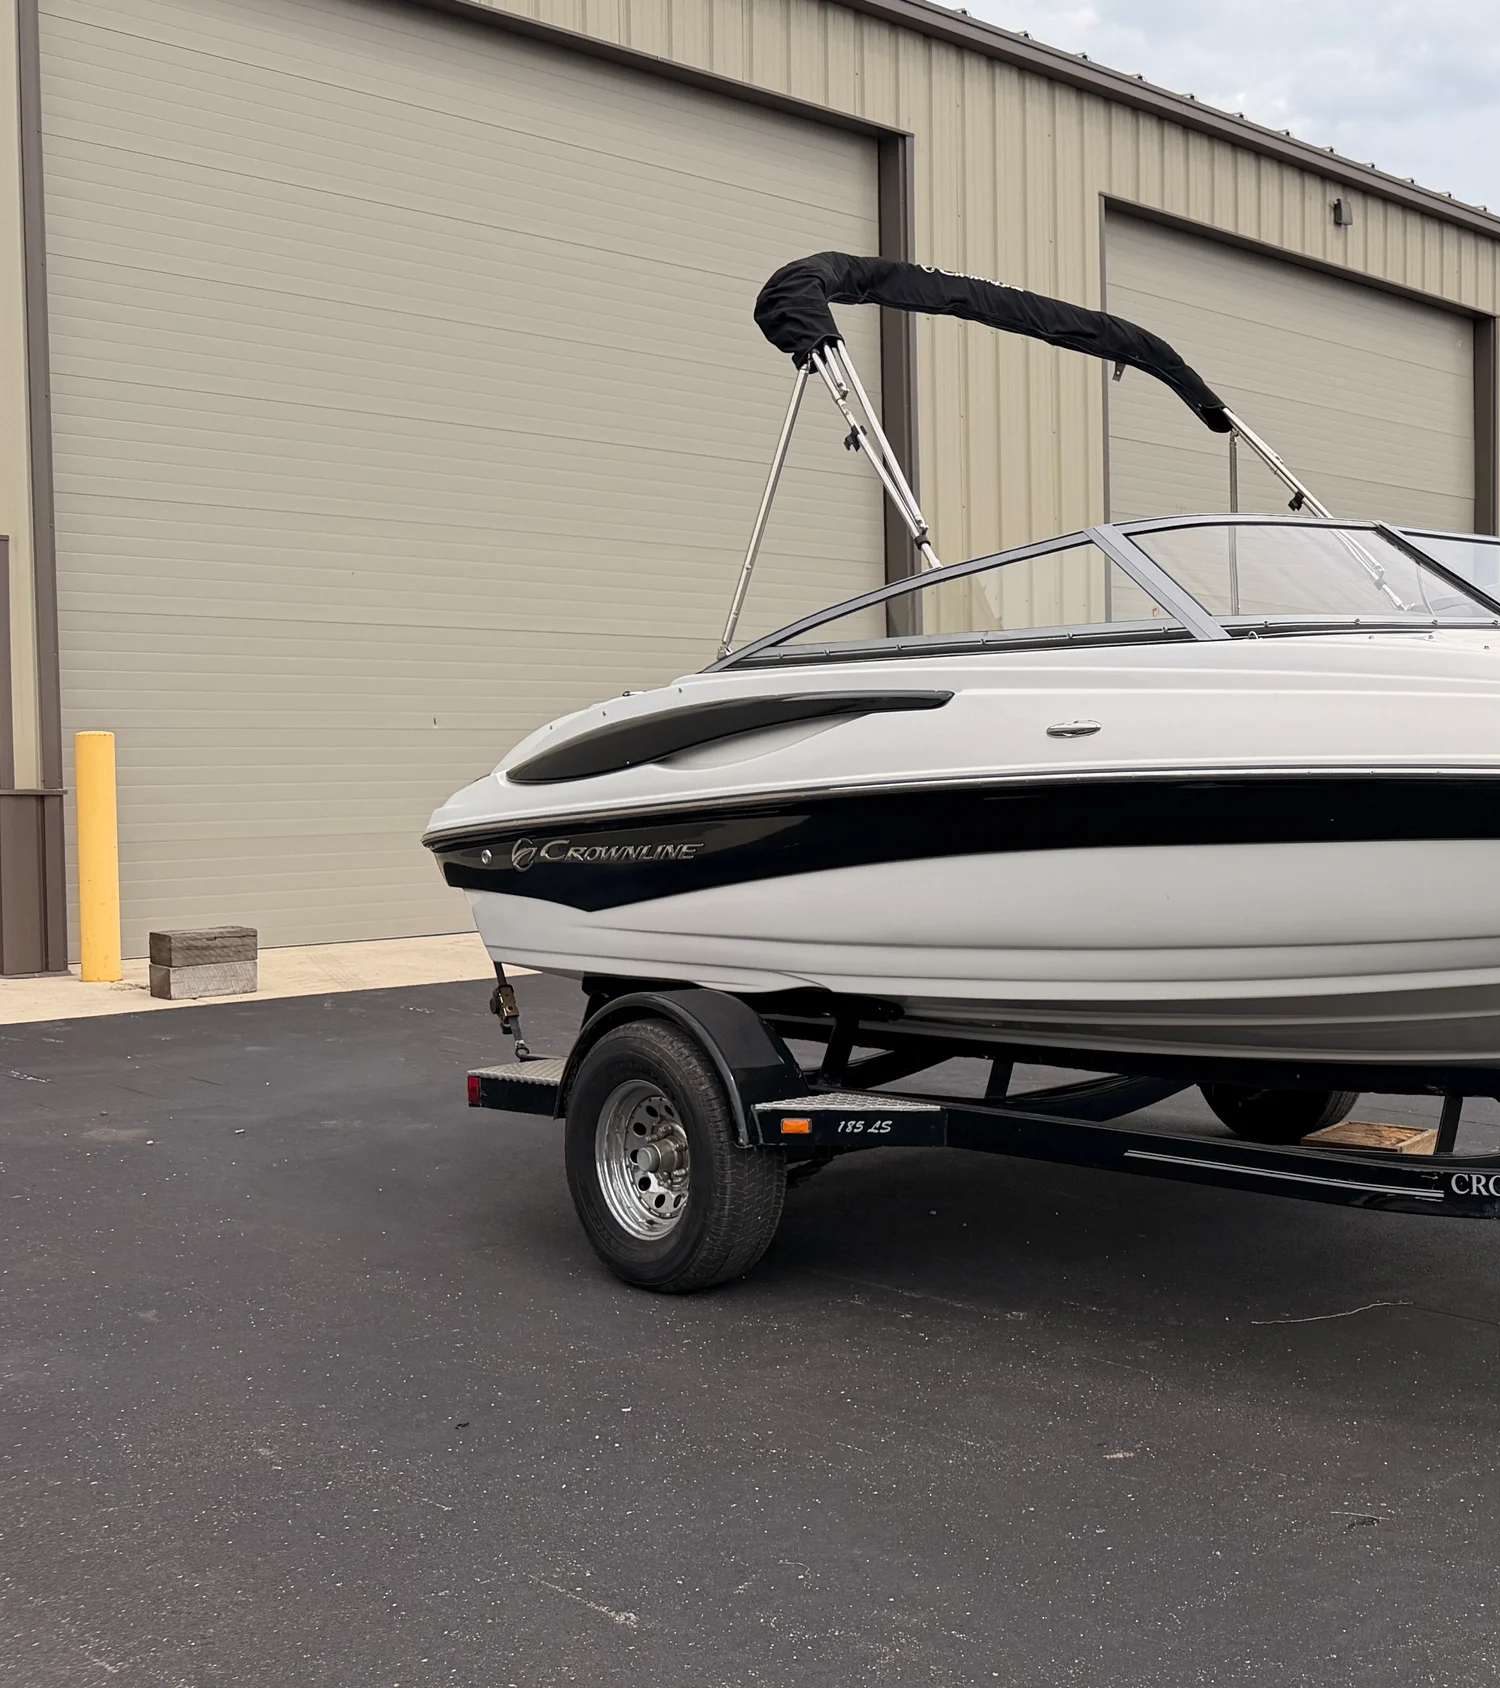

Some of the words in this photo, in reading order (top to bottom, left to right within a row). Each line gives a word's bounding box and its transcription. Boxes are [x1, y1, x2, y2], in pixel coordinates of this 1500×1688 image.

[540, 839, 704, 861] CROWNLINE
[838, 1121, 865, 1133] 185
[867, 1120, 893, 1133] LS
